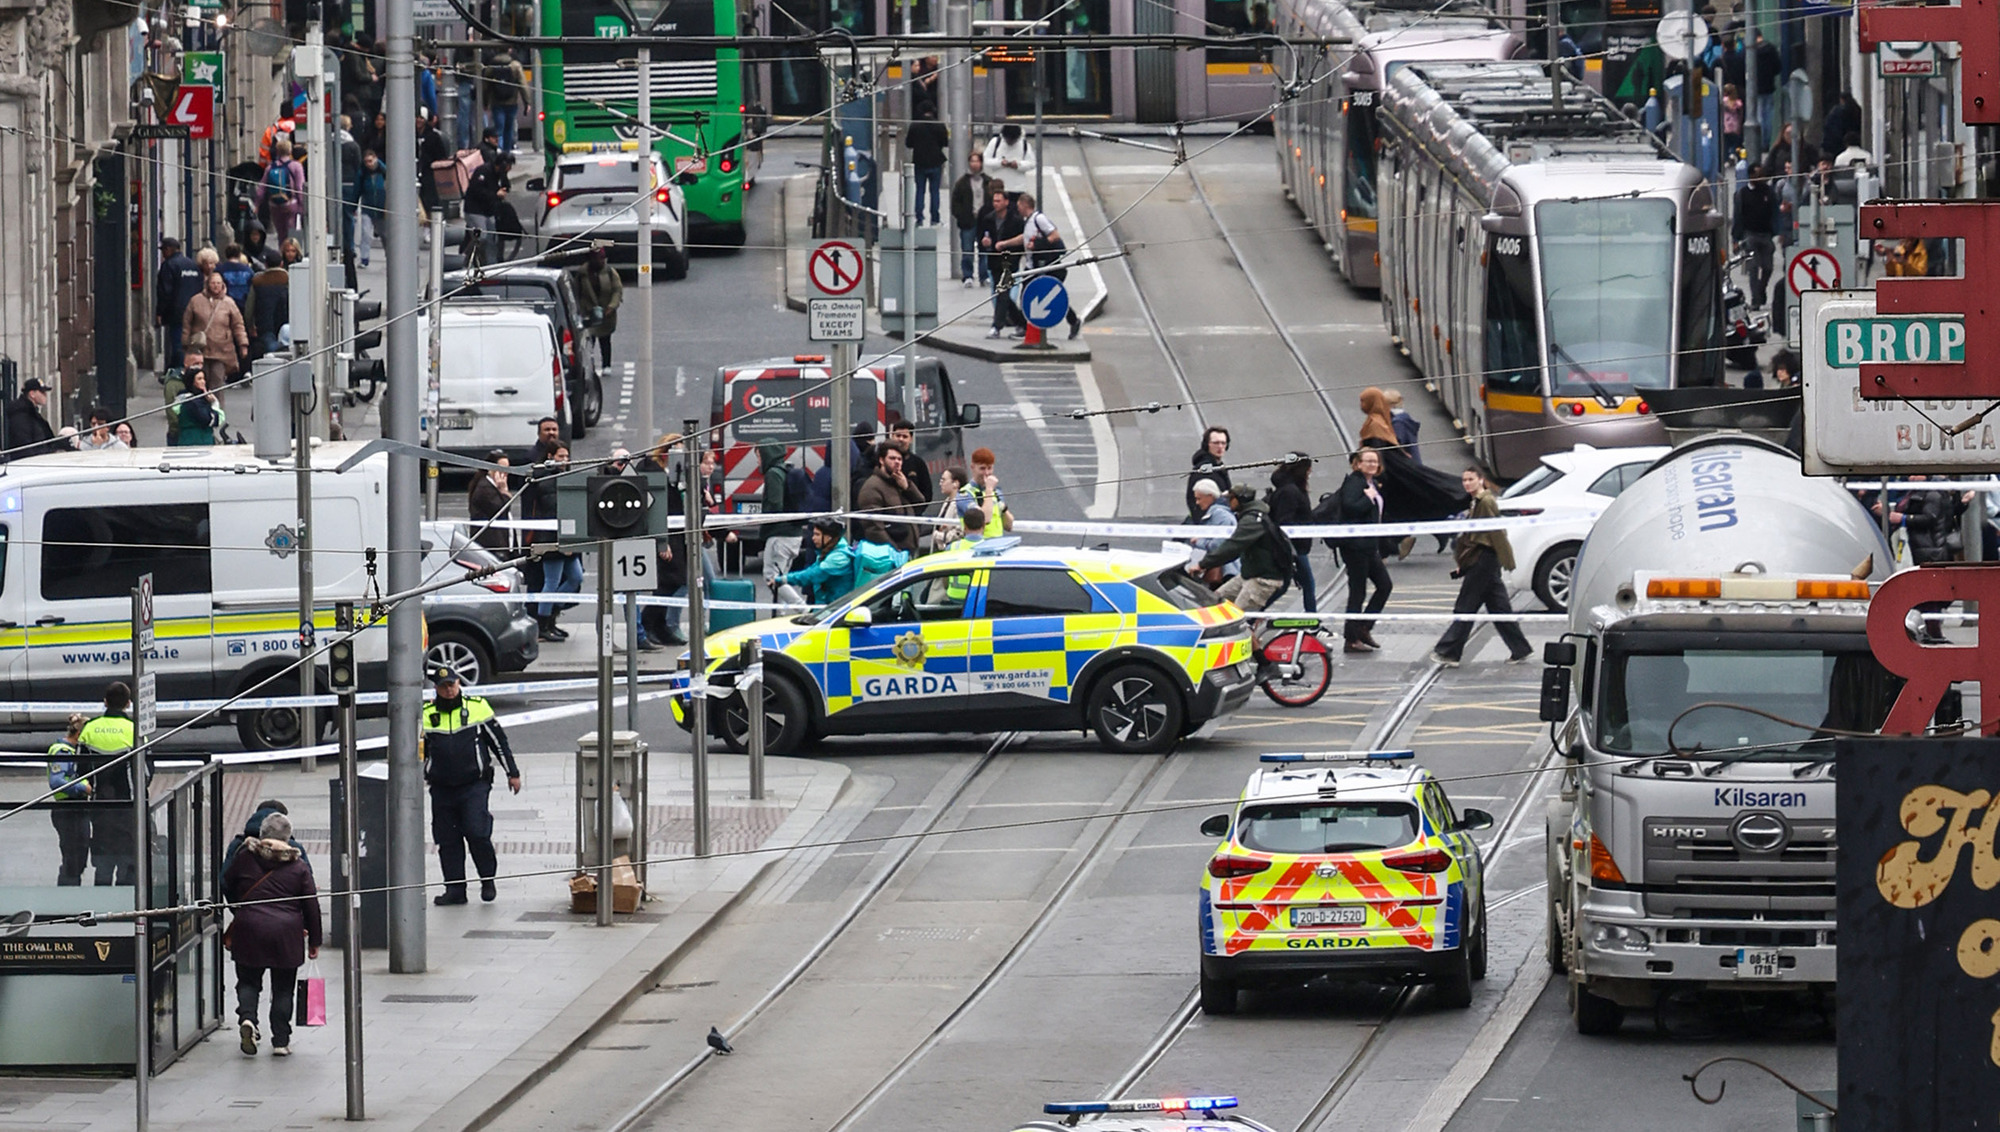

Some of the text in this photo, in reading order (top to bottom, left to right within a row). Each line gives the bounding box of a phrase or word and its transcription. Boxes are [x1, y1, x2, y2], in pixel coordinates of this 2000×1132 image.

[1884, 62, 1932, 73] SPAR
[138, 128, 187, 136] GUINNESS
[1496, 238, 1522, 255] 4006
[1688, 238, 1710, 253] 4006
[617, 555, 647, 577] 15
[251, 642, 257, 651] 1
[262, 639, 288, 652] 800
[63, 646, 180, 664] www.gaa.ie
[979, 670, 1049, 680] www.garda.ie
[865, 675, 958, 697] GARDA
[1032, 680, 1046, 688] 111
[1714, 787, 1807, 807] Kilsaran
[1653, 828, 1707, 838] HINO
[1300, 910, 1362, 923] 201-D-27520
[3, 943, 74, 951] THE OVAL BAR
[1287, 938, 1371, 949] GARDA
